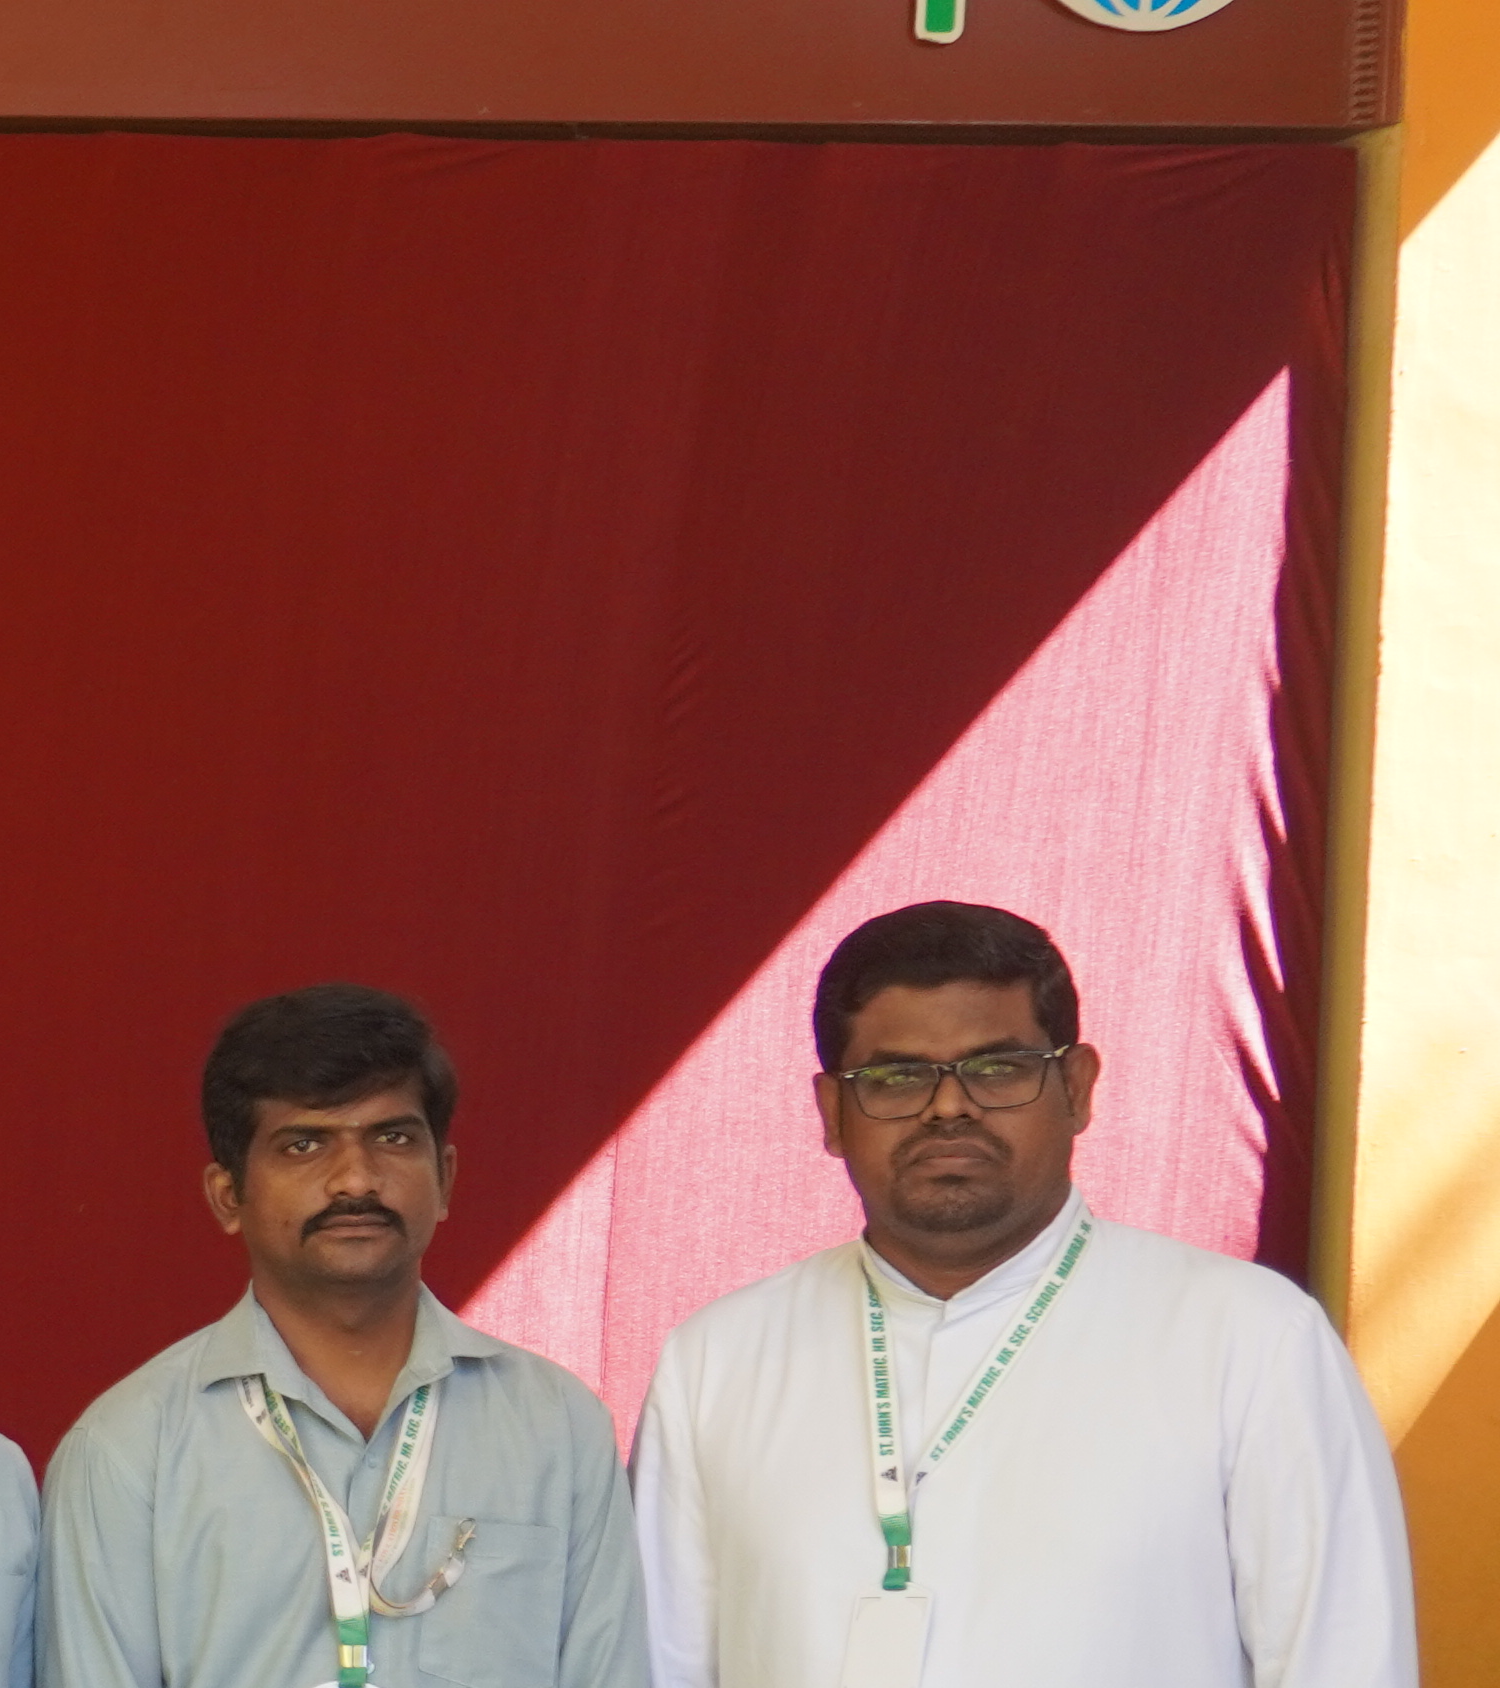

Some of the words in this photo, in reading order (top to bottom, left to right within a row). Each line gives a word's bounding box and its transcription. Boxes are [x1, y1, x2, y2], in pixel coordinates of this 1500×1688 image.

[870, 1309, 885, 1332] SEC.
[872, 1334, 887, 1352] HR.
[929, 1446, 946, 1461] ST.
[942, 1407, 974, 1445] JOHN'S
[967, 1366, 1004, 1410] MATRIC.
[996, 1347, 1017, 1367] HR.
[1009, 1324, 1033, 1347] SEC.
[1055, 1234, 1087, 1280] MADURAI
[873, 1355, 889, 1399] MATRIC.
[405, 1419, 422, 1440] SEC.
[876, 1402, 893, 1438] JOHN'S
[400, 1442, 414, 1459] HR.
[879, 1440, 894, 1457] ST.
[386, 1460, 408, 1503] MATRIC.
